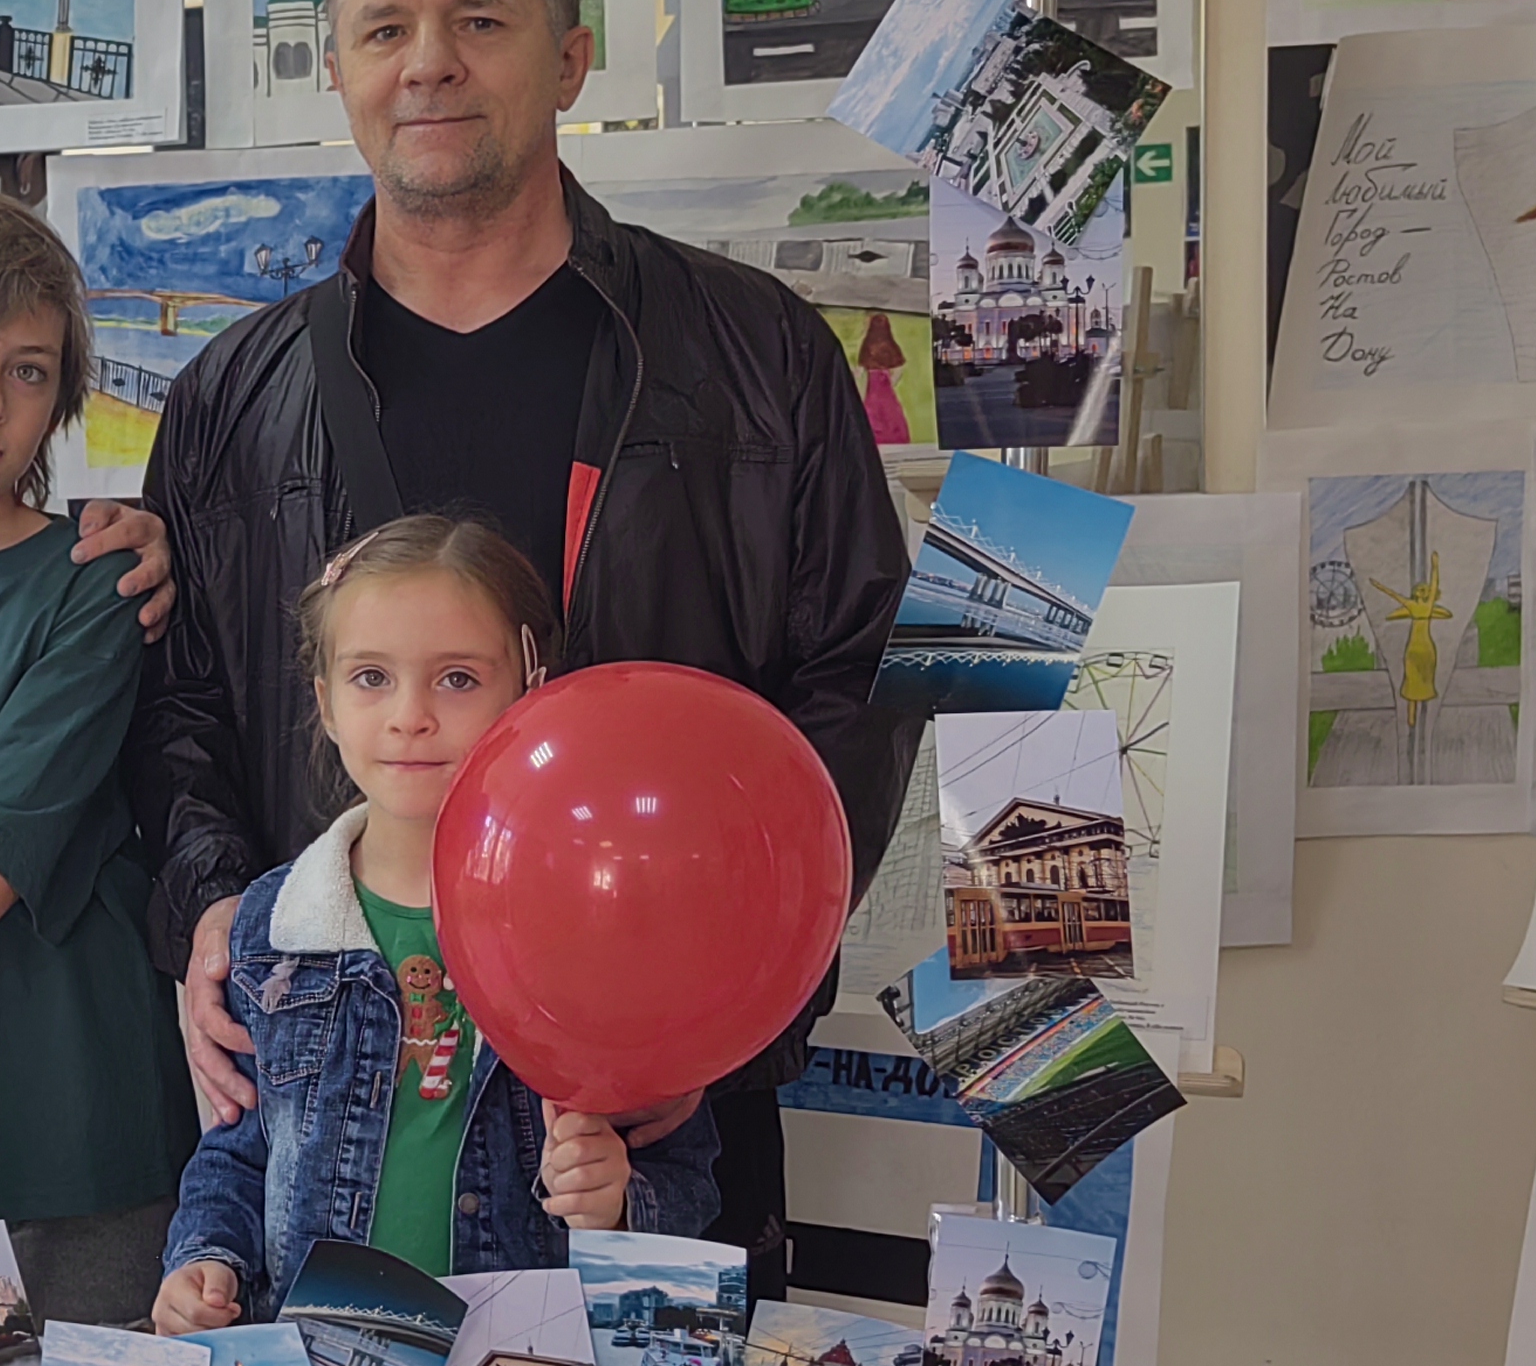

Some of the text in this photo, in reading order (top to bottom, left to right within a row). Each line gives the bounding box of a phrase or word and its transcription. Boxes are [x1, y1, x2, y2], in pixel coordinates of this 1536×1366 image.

[1330, 112, 1397, 166] Мой
[1316, 251, 1412, 289] Ростов
[1319, 290, 1359, 320] На
[1320, 325, 1395, 377] Дону
